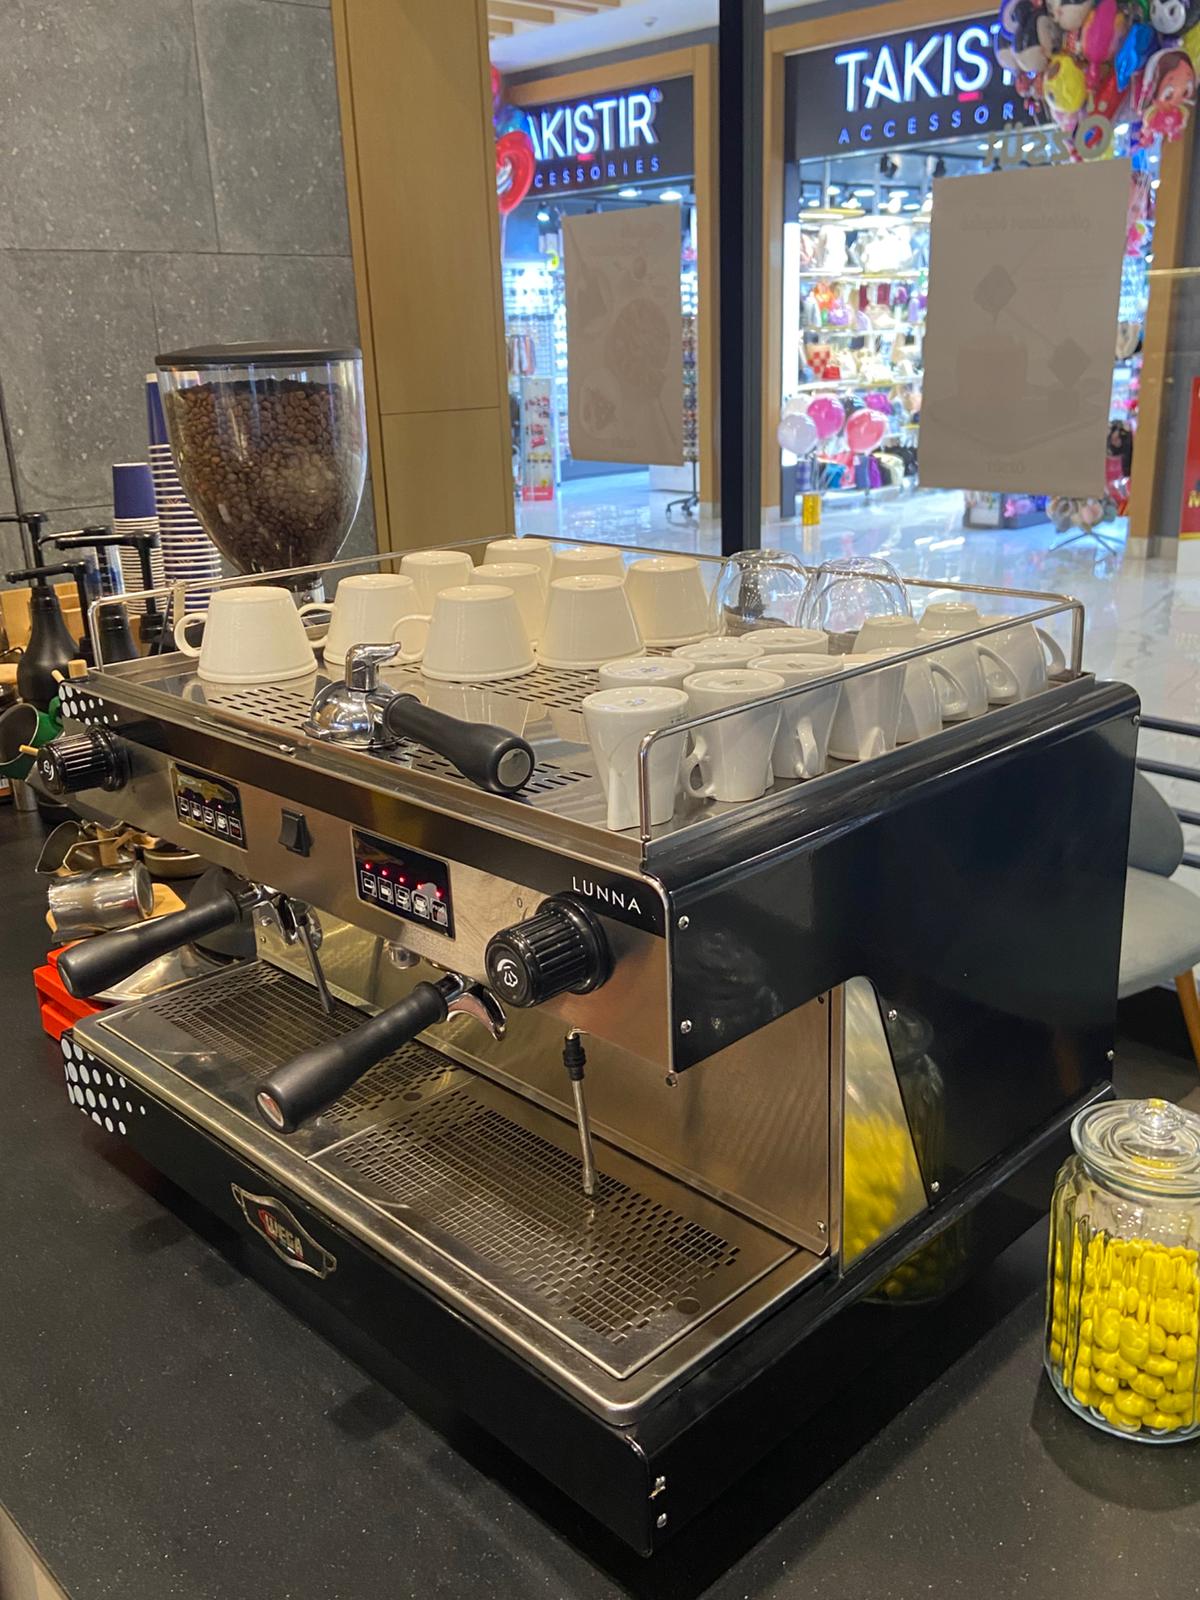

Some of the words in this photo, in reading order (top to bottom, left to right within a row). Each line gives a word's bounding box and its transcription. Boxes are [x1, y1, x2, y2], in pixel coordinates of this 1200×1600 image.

[834, 23, 1012, 112] TAKIS
[527, 93, 657, 161] KISTIR
[838, 101, 1035, 145] ACCESSORI
[534, 157, 660, 188] CESSORIES
[572, 876, 641, 915] LUNNA
